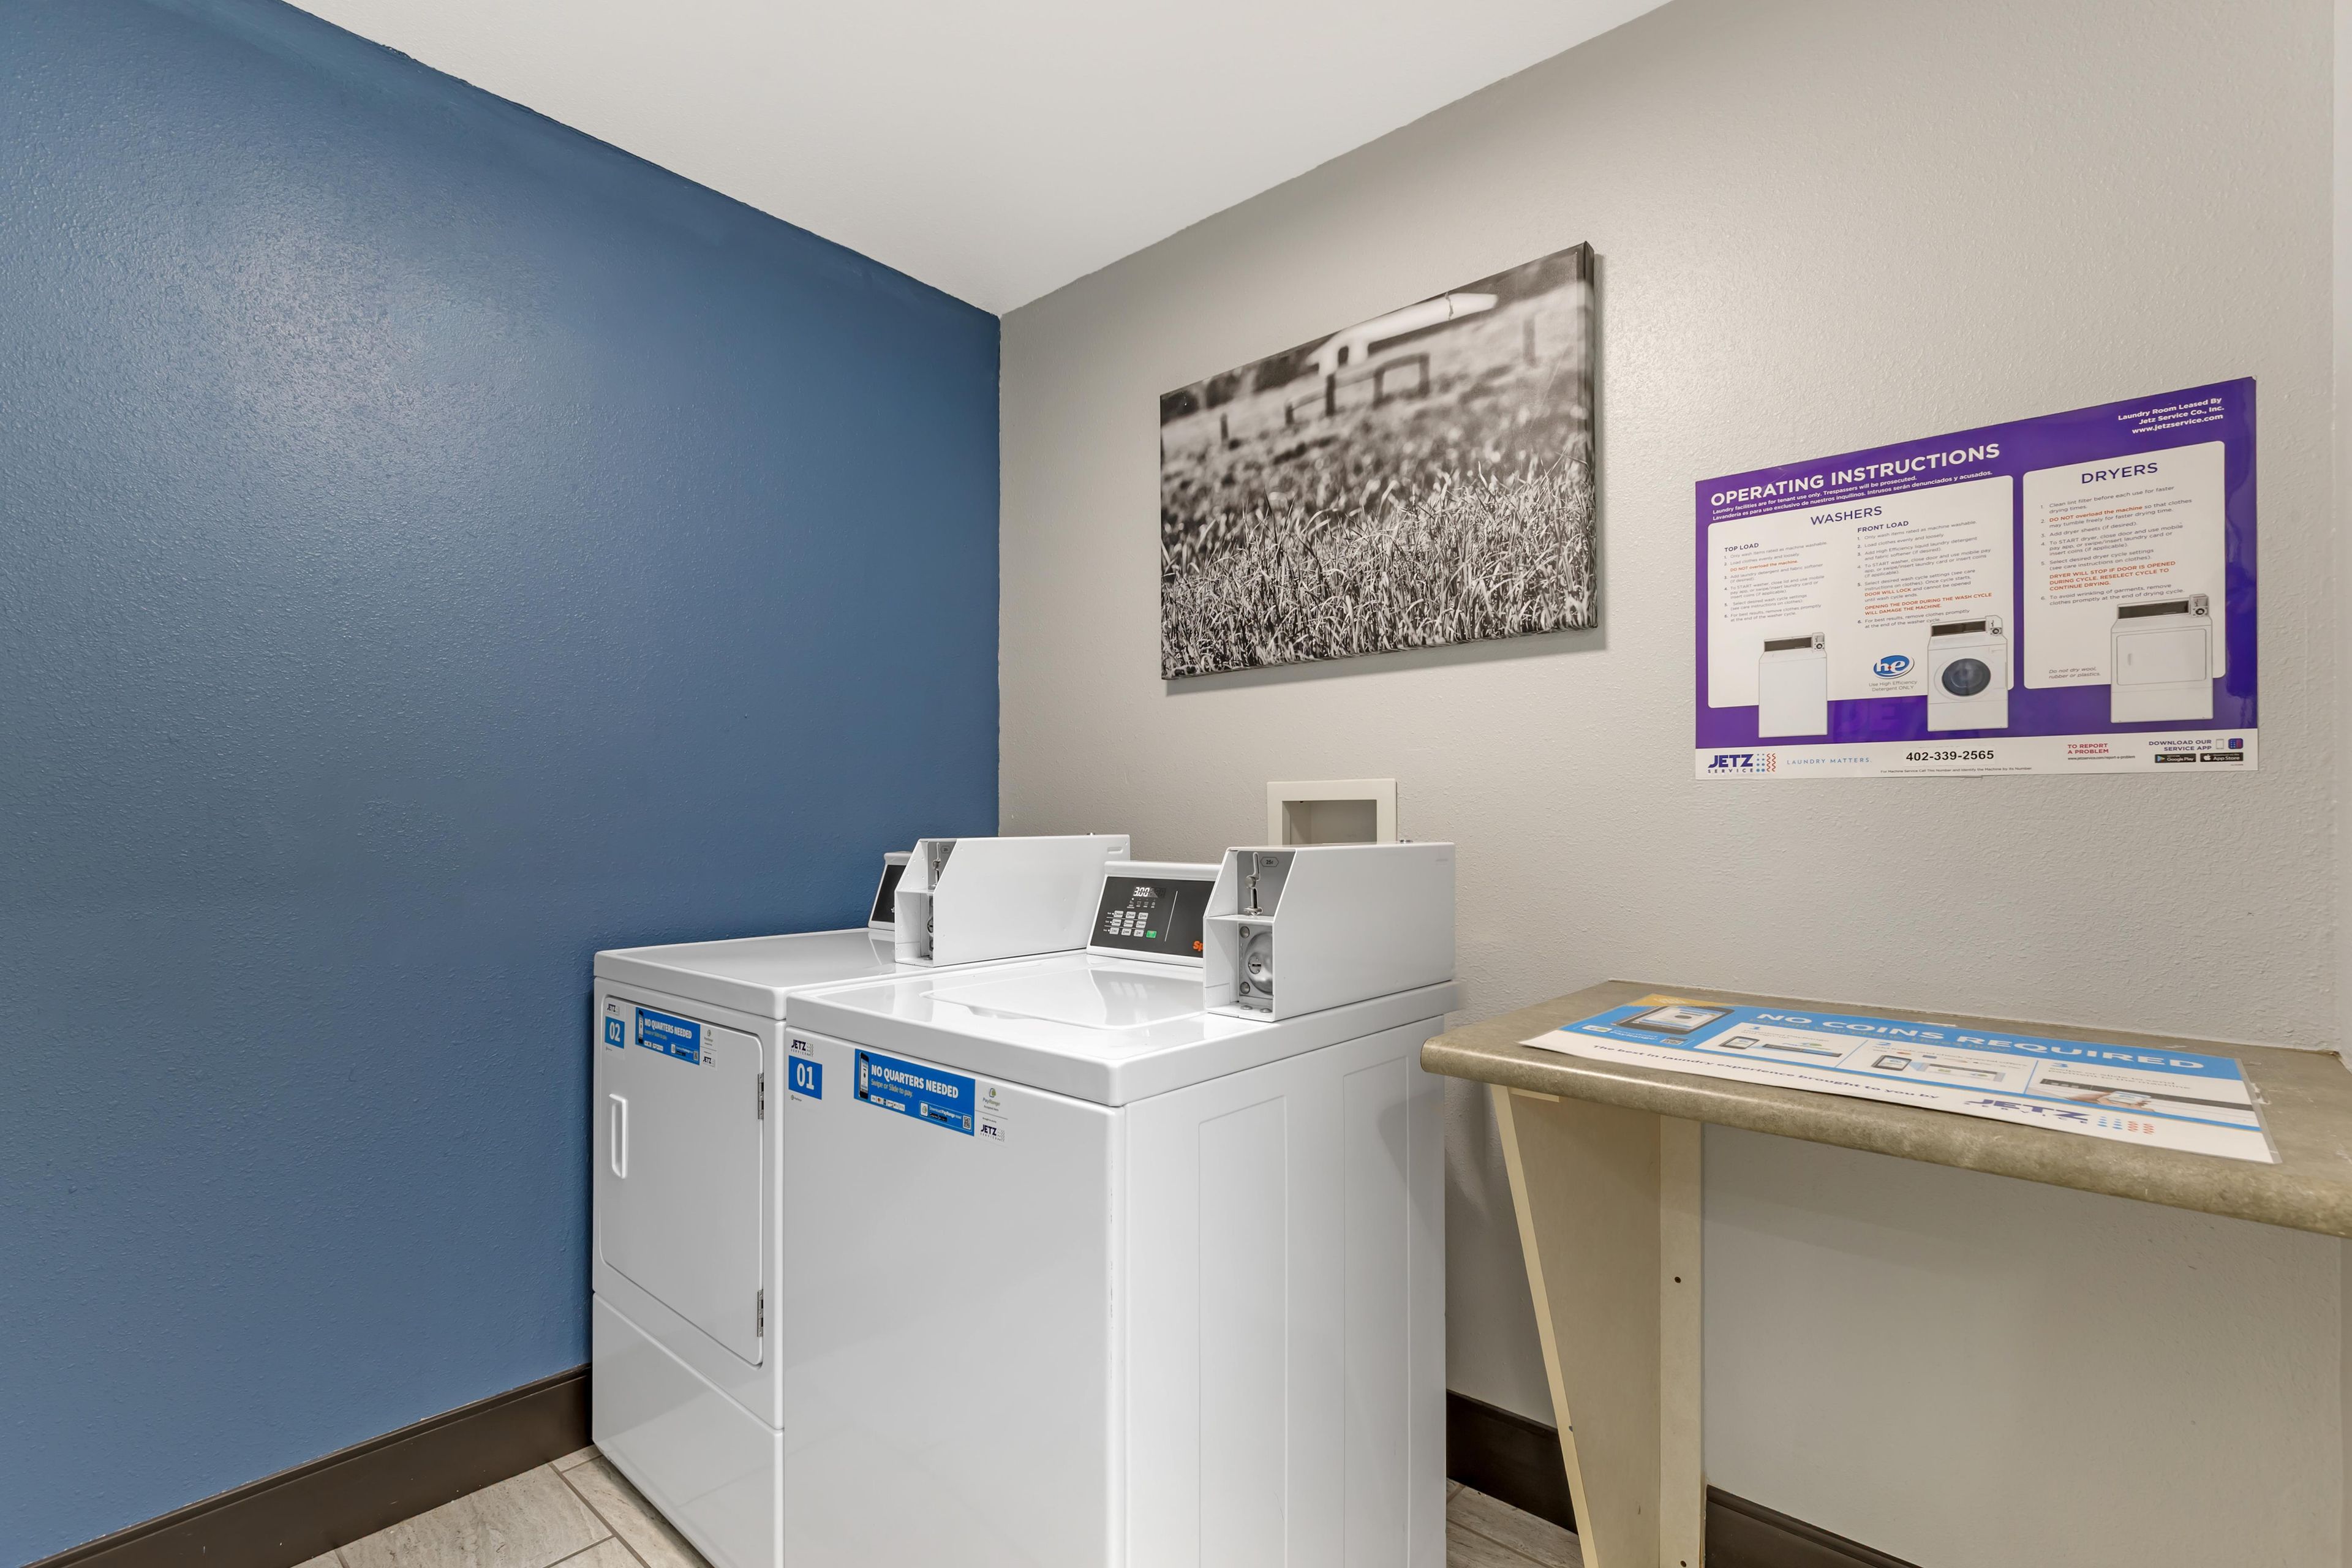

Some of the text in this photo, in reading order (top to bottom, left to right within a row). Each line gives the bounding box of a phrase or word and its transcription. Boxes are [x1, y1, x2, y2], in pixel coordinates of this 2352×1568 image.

[2118, 410, 2150, 420] Laundry
[2179, 399, 2208, 409] Leased
[2158, 412, 2188, 421] Service
[2132, 415, 2223, 433] www.jetzservice.com
[1711, 443, 2000, 507] OPERATING INSTRUCTIONS
[2081, 462, 2158, 484] DRYERS
[1713, 511, 1741, 519] Lavandería
[1912, 478, 1951, 487] denunciados
[1823, 486, 1857, 495] Trespassers
[1811, 506, 1882, 526] WASHERS
[1708, 753, 1754, 768] JETZ
[1906, 750, 1993, 761] 402-339-2565
[607, 1003, 616, 1012] JETZ
[609, 1022, 620, 1041] 02
[652, 1020, 673, 1034] QUARTERS
[674, 1026, 692, 1039] NEEDED
[791, 1039, 806, 1051] JETZ
[1757, 1013, 1812, 1024] NO
[1822, 1020, 1945, 1039] COINS
[1957, 1036, 2204, 1069] REQUIRED
[797, 1063, 814, 1090] 01
[1662, 1056, 1714, 1065] laundry
[1717, 1063, 1795, 1076] experience
[1798, 1075, 1860, 1087] brought
[871, 1065, 959, 1098] NO QUARTERS NEEDED
[871, 1078, 883, 1088] Swipe
[889, 1084, 899, 1092] Slide
[1964, 1099, 2090, 1121] JETZ
[981, 1125, 997, 1136] JETZ
